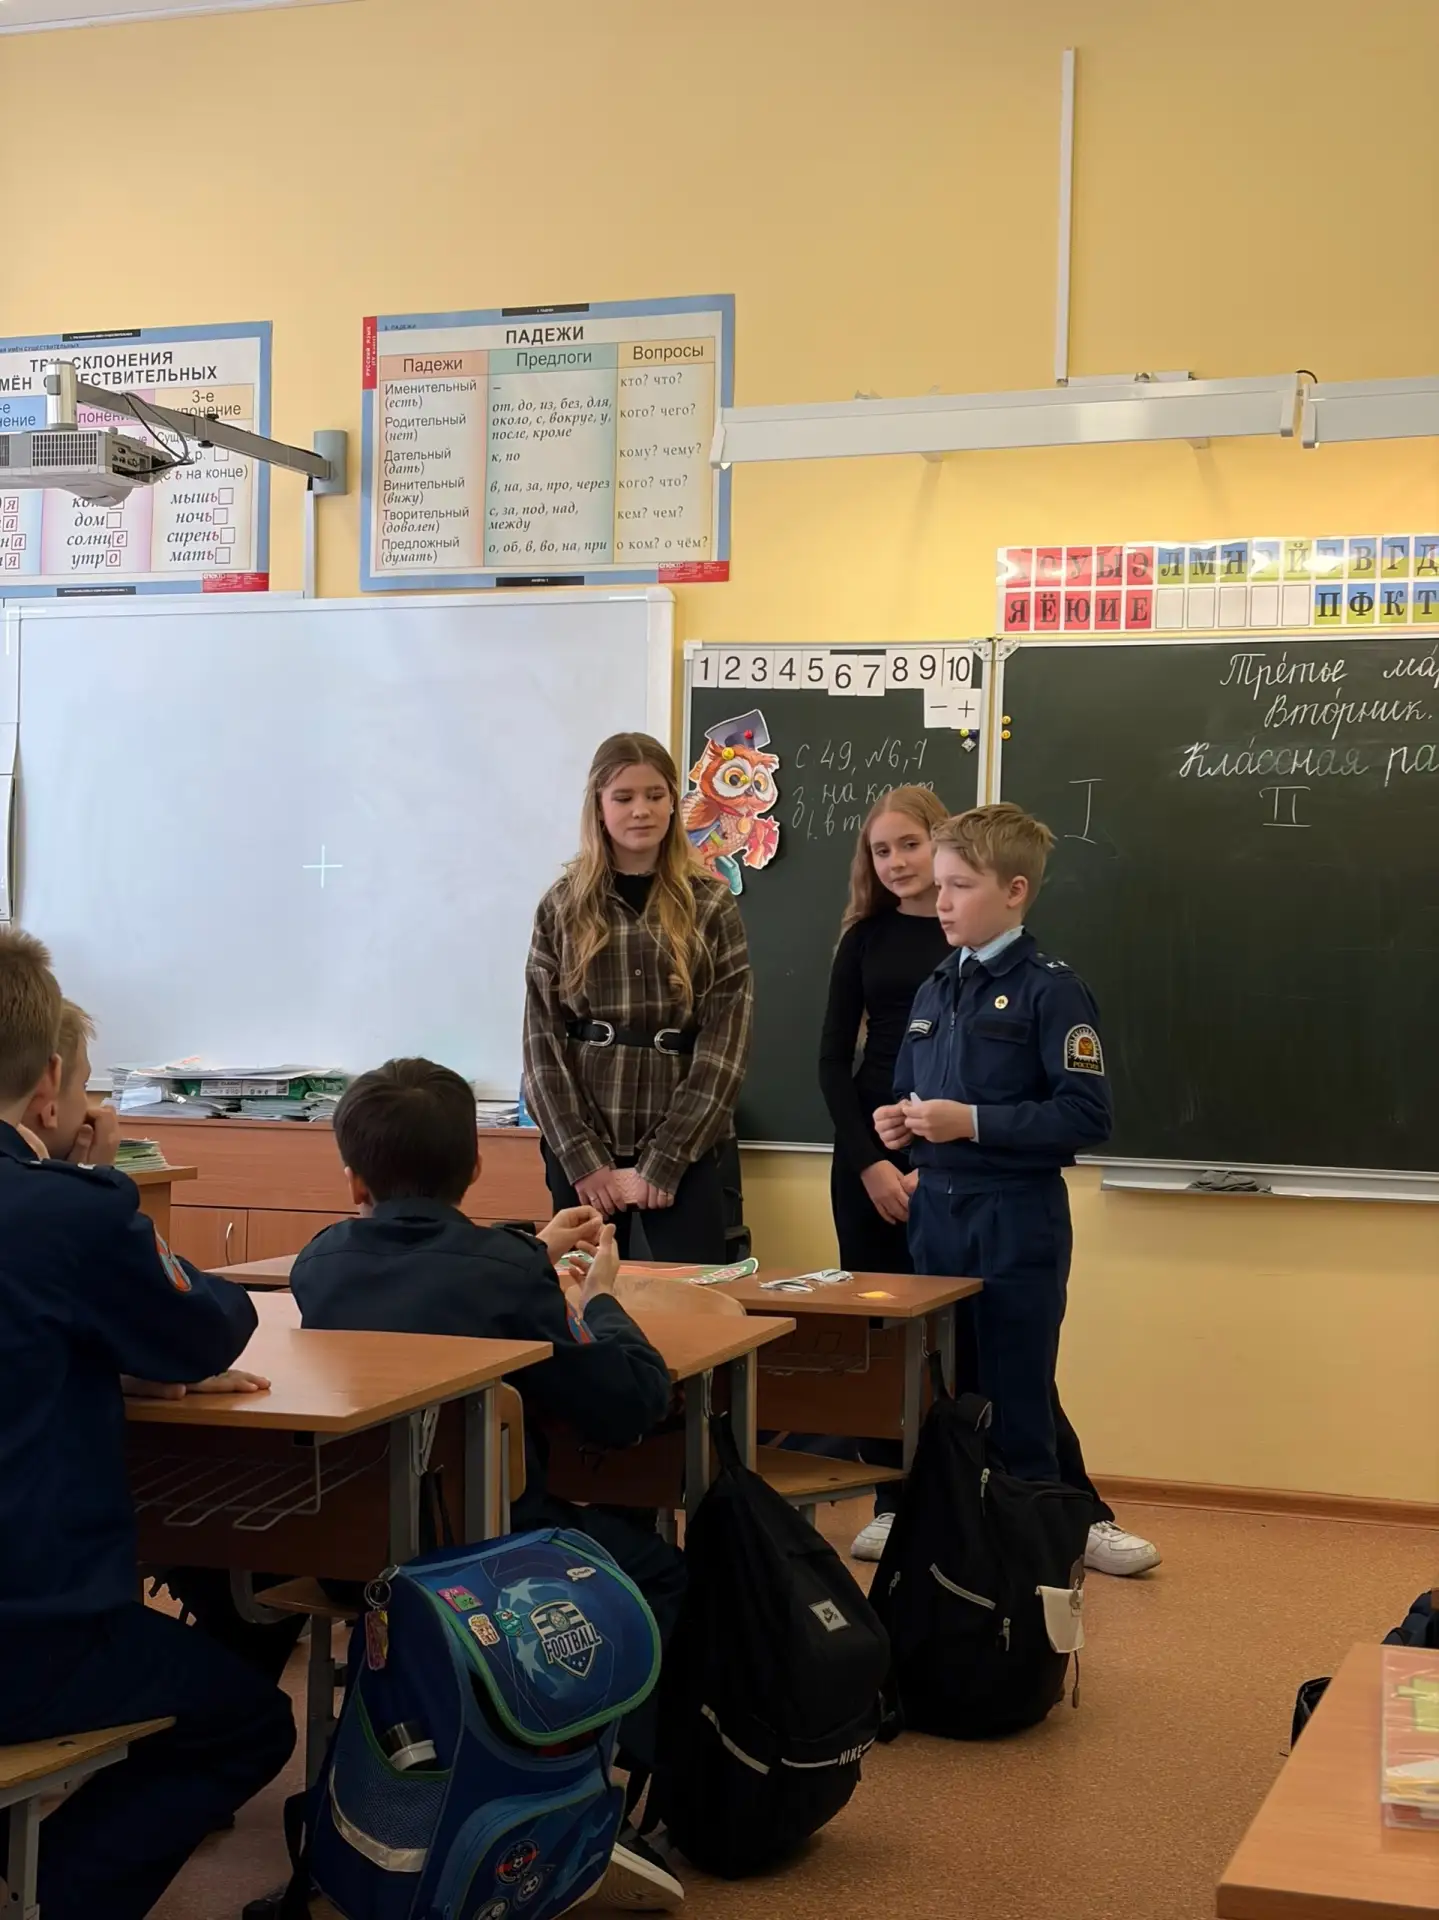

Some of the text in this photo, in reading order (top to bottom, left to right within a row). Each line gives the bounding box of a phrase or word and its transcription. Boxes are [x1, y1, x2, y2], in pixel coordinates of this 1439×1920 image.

[506, 326, 584, 345] ПАДЕЖИ
[72, 351, 173, 370] СКЛОНЕНИЯ
[516, 352, 592, 369] Предлоги
[633, 345, 704, 362] Вопросы
[403, 358, 463, 373] Падежи
[385, 379, 477, 395] Именительный
[620, 372, 682, 387] кто? что?
[192, 389, 215, 403] 3-е
[385, 395, 423, 411] (есть)
[492, 396, 612, 412] от, до, из, без, для,
[620, 403, 696, 418] кого? чего?
[385, 413, 466, 428] Родительный
[492, 416, 532, 427] около,
[536, 416, 545, 426] с,
[549, 411, 596, 426] вокруг,
[385, 429, 418, 443] (нет)
[491, 428, 572, 441] после, кроме
[384, 447, 451, 463] Дательный
[491, 453, 520, 463] к, по
[619, 442, 702, 460] кому? чему?
[187, 469, 202, 480] на
[206, 466, 249, 482] конце)
[384, 462, 424, 477] (дать)
[384, 477, 465, 491] Винительный
[490, 480, 610, 494] в, на, за, про, через
[618, 474, 688, 488] кого? что?
[170, 491, 218, 505] мышь
[383, 491, 424, 506] (вижу)
[382, 506, 469, 521] Творительный
[489, 501, 578, 517] с, за, под, над,
[617, 505, 684, 519] кем? чем?
[74, 511, 105, 527] дом
[176, 511, 212, 524] ночь
[488, 517, 531, 532] между
[382, 520, 440, 536] (доволен)
[66, 529, 127, 548] солнце
[167, 530, 219, 547] сирень
[381, 536, 460, 552] Предложный
[616, 535, 708, 550] о ком? о чём?
[488, 544, 499, 554] о,
[503, 541, 521, 553] об,
[525, 540, 536, 553] в,
[540, 540, 558, 553] во,
[584, 541, 607, 553] при
[71, 551, 120, 570] утро
[169, 549, 215, 563] мать
[381, 549, 437, 566] (думать)
[1070, 555, 1089, 580] У
[1096, 553, 1123, 578] Ы
[1132, 552, 1149, 577] Э
[1160, 552, 1182, 576] Л
[1192, 551, 1217, 576] М
[1224, 550, 1245, 575] Н
[1353, 545, 1373, 571] В
[1387, 544, 1405, 570] Г
[1416, 543, 1439, 577] Д
[1008, 589, 1437, 624] Я Ё Ю И Е П Ф К Т
[700, 654, 971, 689] 1 2 3 4 5 6 7 8 9 10
[822, 782, 858, 805] на
[544, 1623, 601, 1662] FOOTBALL
[839, 1744, 862, 1766] NIKE
